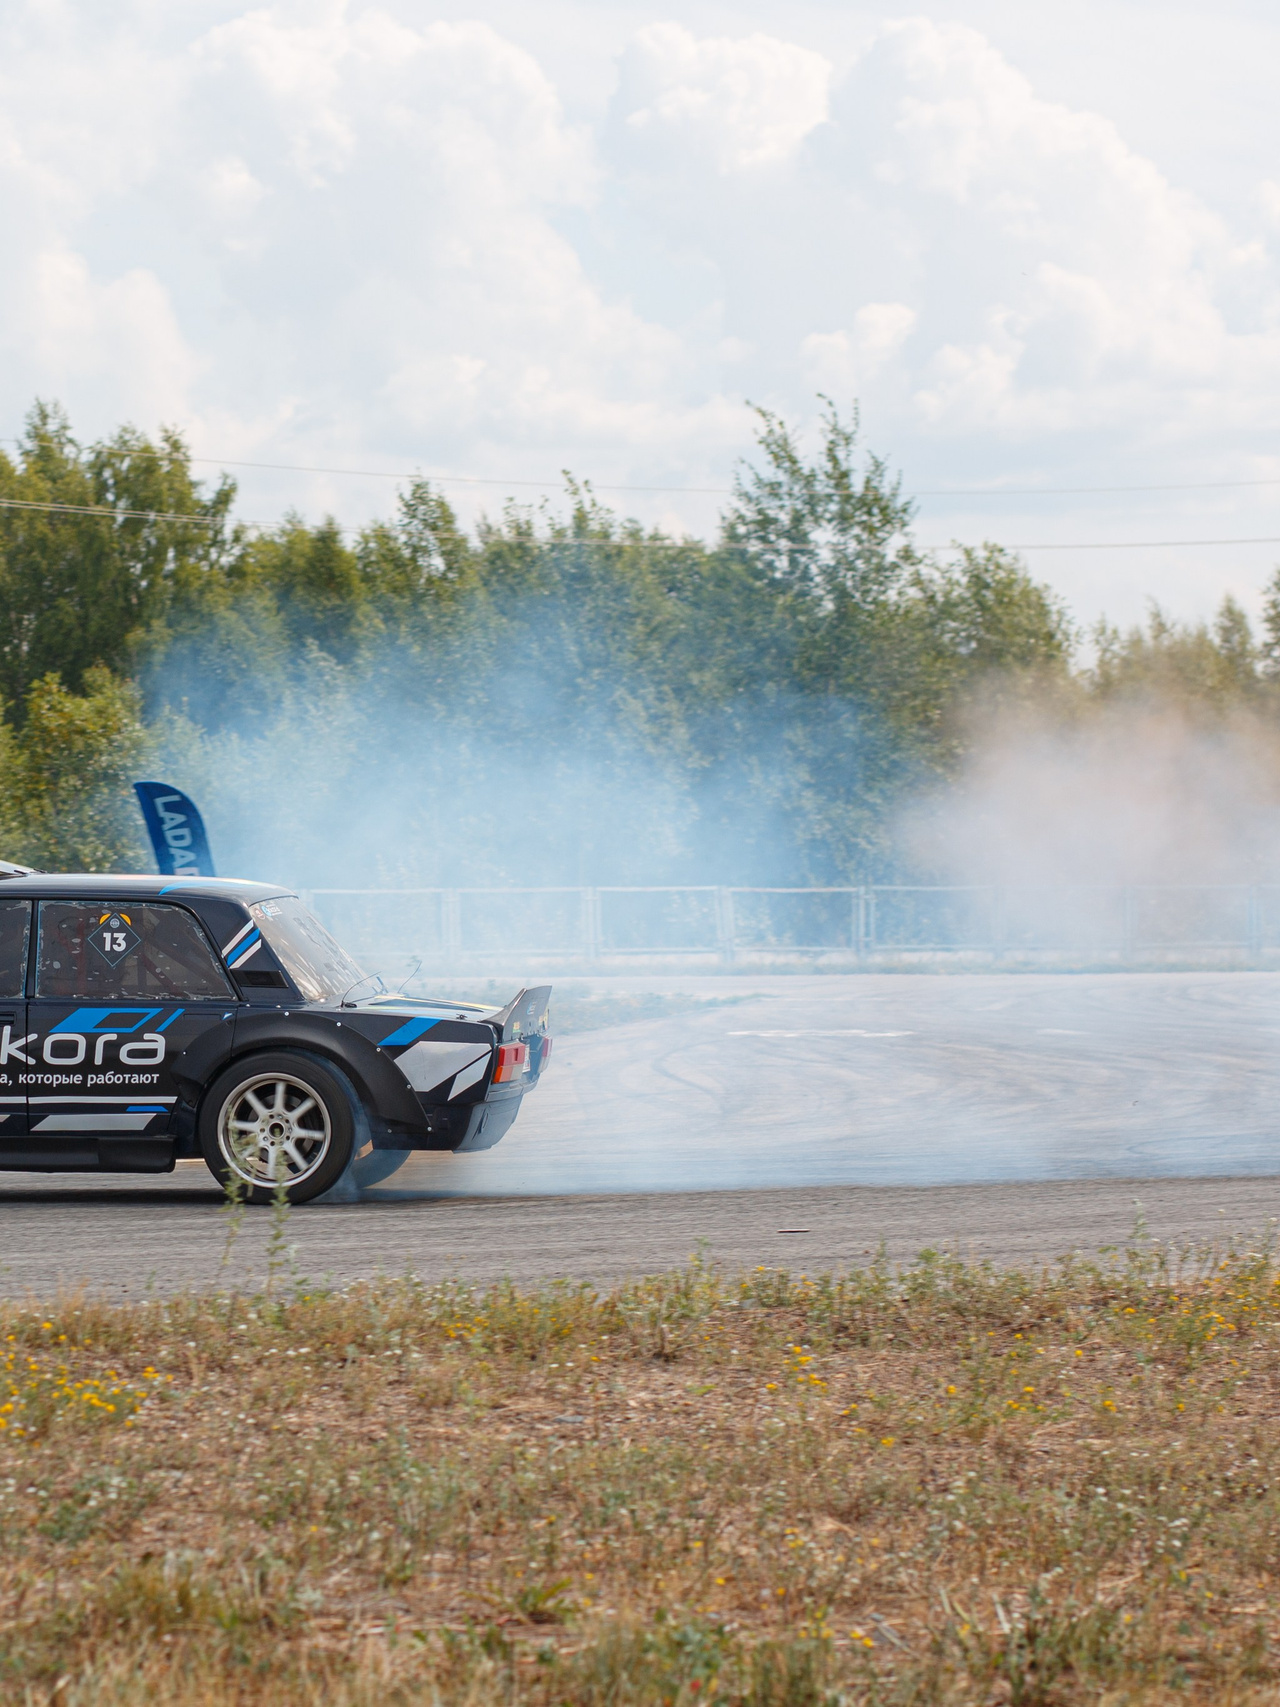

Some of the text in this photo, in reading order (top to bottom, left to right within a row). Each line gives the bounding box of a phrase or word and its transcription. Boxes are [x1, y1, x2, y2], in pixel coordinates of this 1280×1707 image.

[103, 932, 127, 952] 13
[18, 1073, 83, 1087] которые
[86, 1071, 160, 1087] работают
